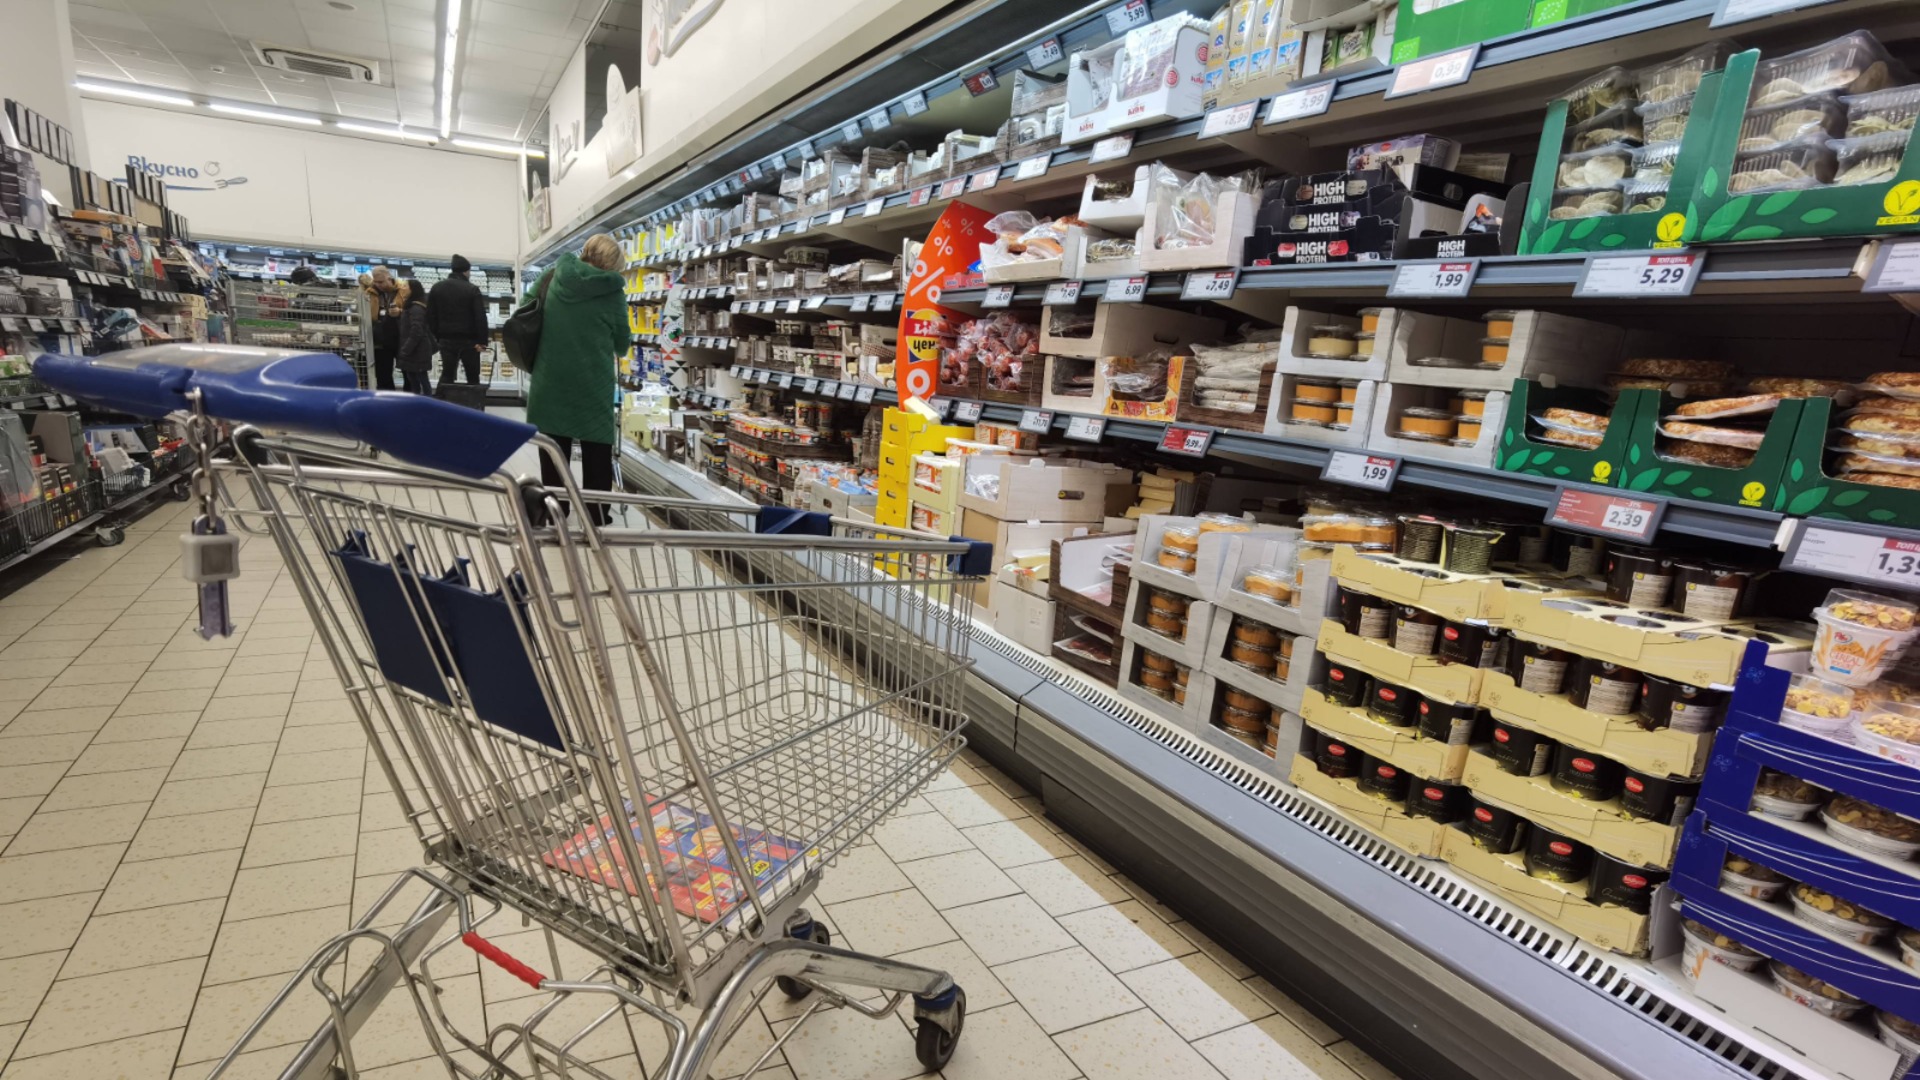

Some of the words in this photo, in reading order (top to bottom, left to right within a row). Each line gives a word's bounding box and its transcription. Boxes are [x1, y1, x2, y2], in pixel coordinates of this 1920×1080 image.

[1435, 62, 1462, 79] 0,99
[1314, 180, 1345, 196] HIGH
[1313, 195, 1345, 205] PROTEIN
[1308, 212, 1339, 227] HIGH
[1878, 215, 1919, 224] VEGAN
[1296, 241, 1327, 255] HIGH
[1438, 239, 1466, 251] HIGH
[1296, 253, 1327, 263] PROTEIN
[1435, 272, 1463, 289] 1,99
[1640, 267, 1684, 286] 5,29
[1125, 285, 1142, 297] 6,99
[1210, 280, 1230, 292] 7,49
[913, 339, 938, 352] цен
[1362, 465, 1388, 480] 1,99
[1609, 510, 1643, 528] 2,39
[1895, 541, 1914, 551] ТОП
